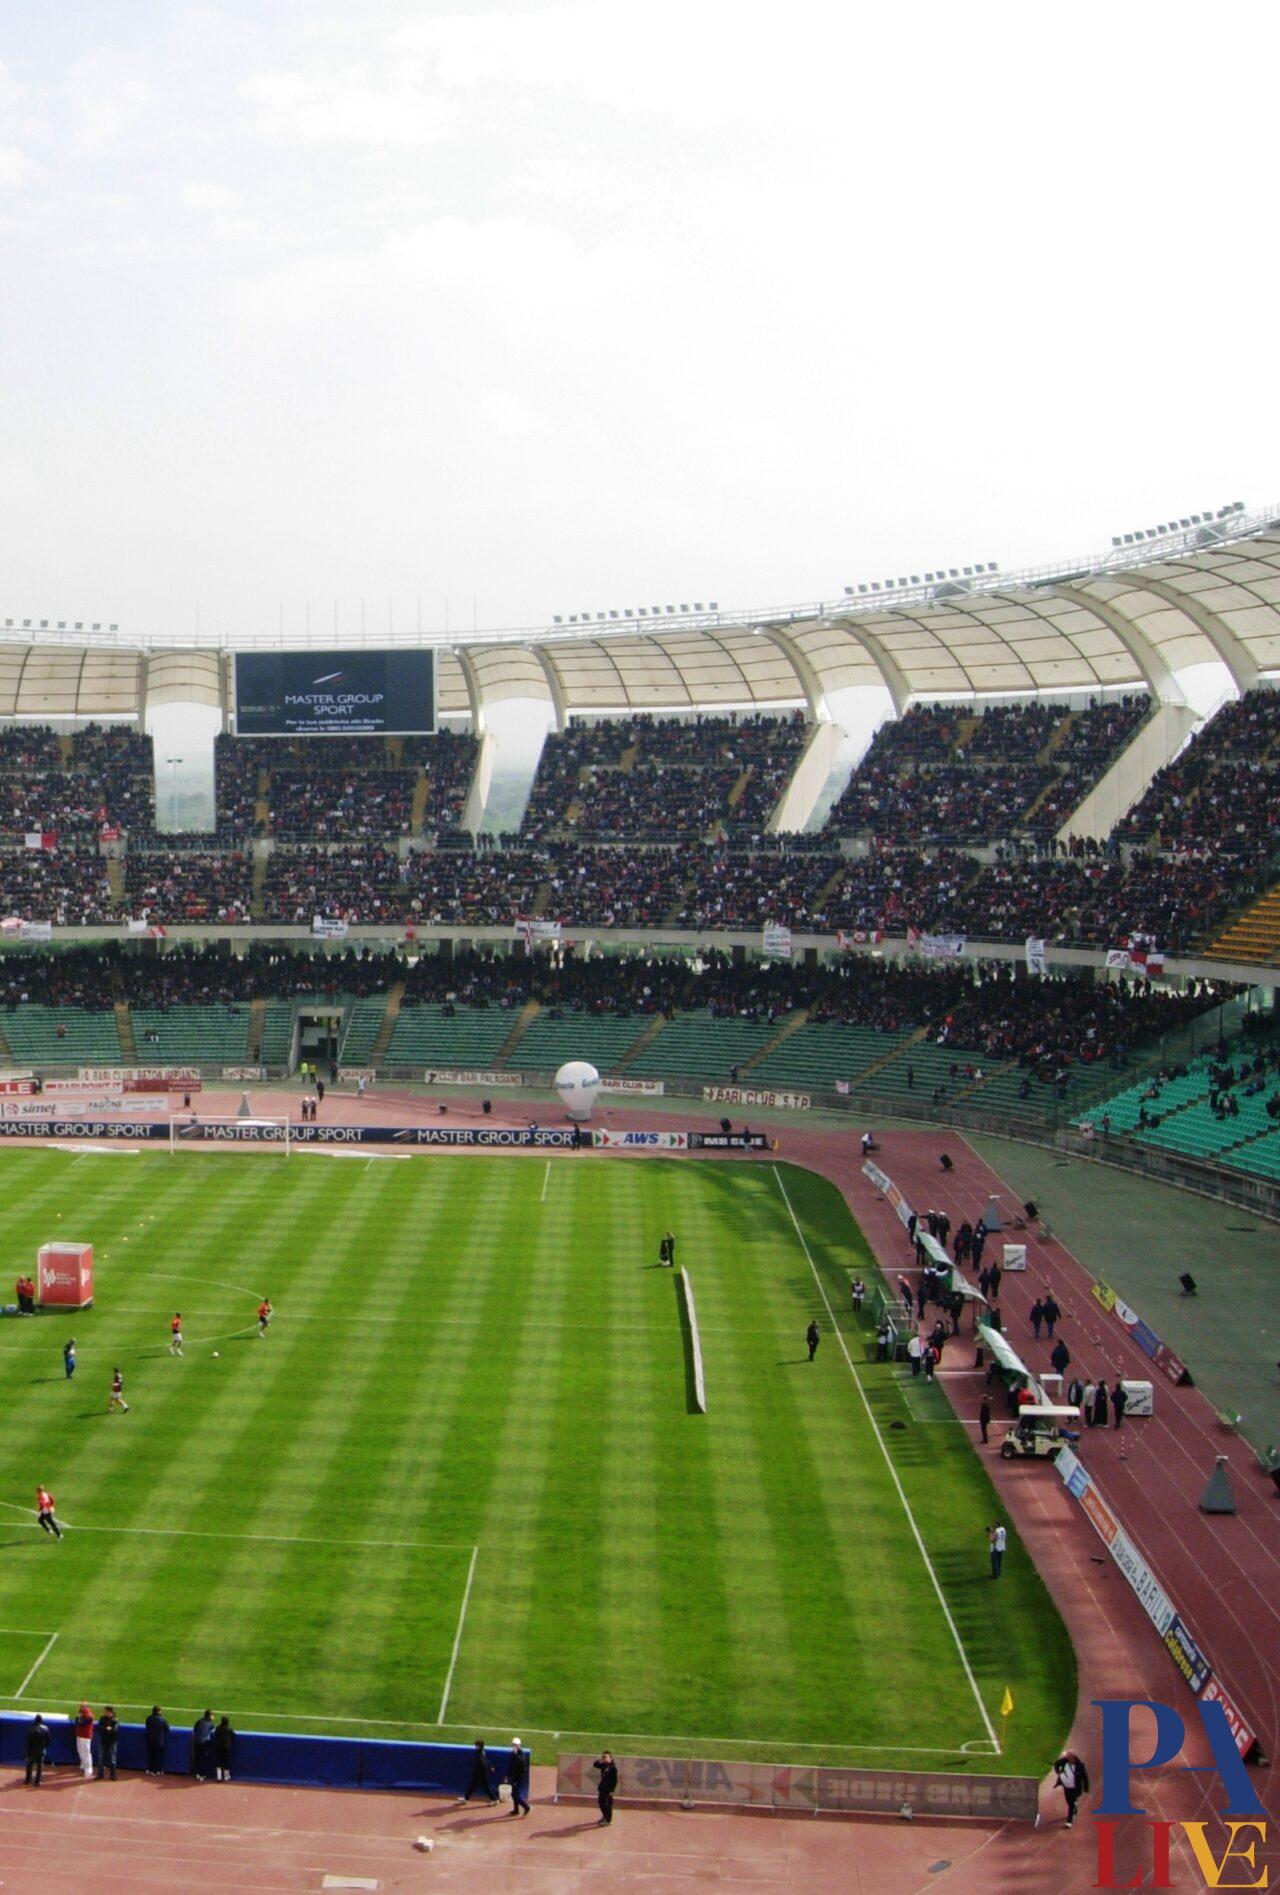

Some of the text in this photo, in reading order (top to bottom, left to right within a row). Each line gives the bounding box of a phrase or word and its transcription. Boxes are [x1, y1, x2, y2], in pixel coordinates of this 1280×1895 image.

[285, 694, 383, 704] MASTER GROUP
[314, 705, 354, 715] SPORT
[53, 1124, 104, 1136] GROUP
[108, 1124, 153, 1136] SPORT
[204, 1126, 364, 1141] MASTER GROUP SPORT
[418, 1130, 577, 1145] MASTER GROUP SPOR
[623, 1133, 659, 1144] AWS
